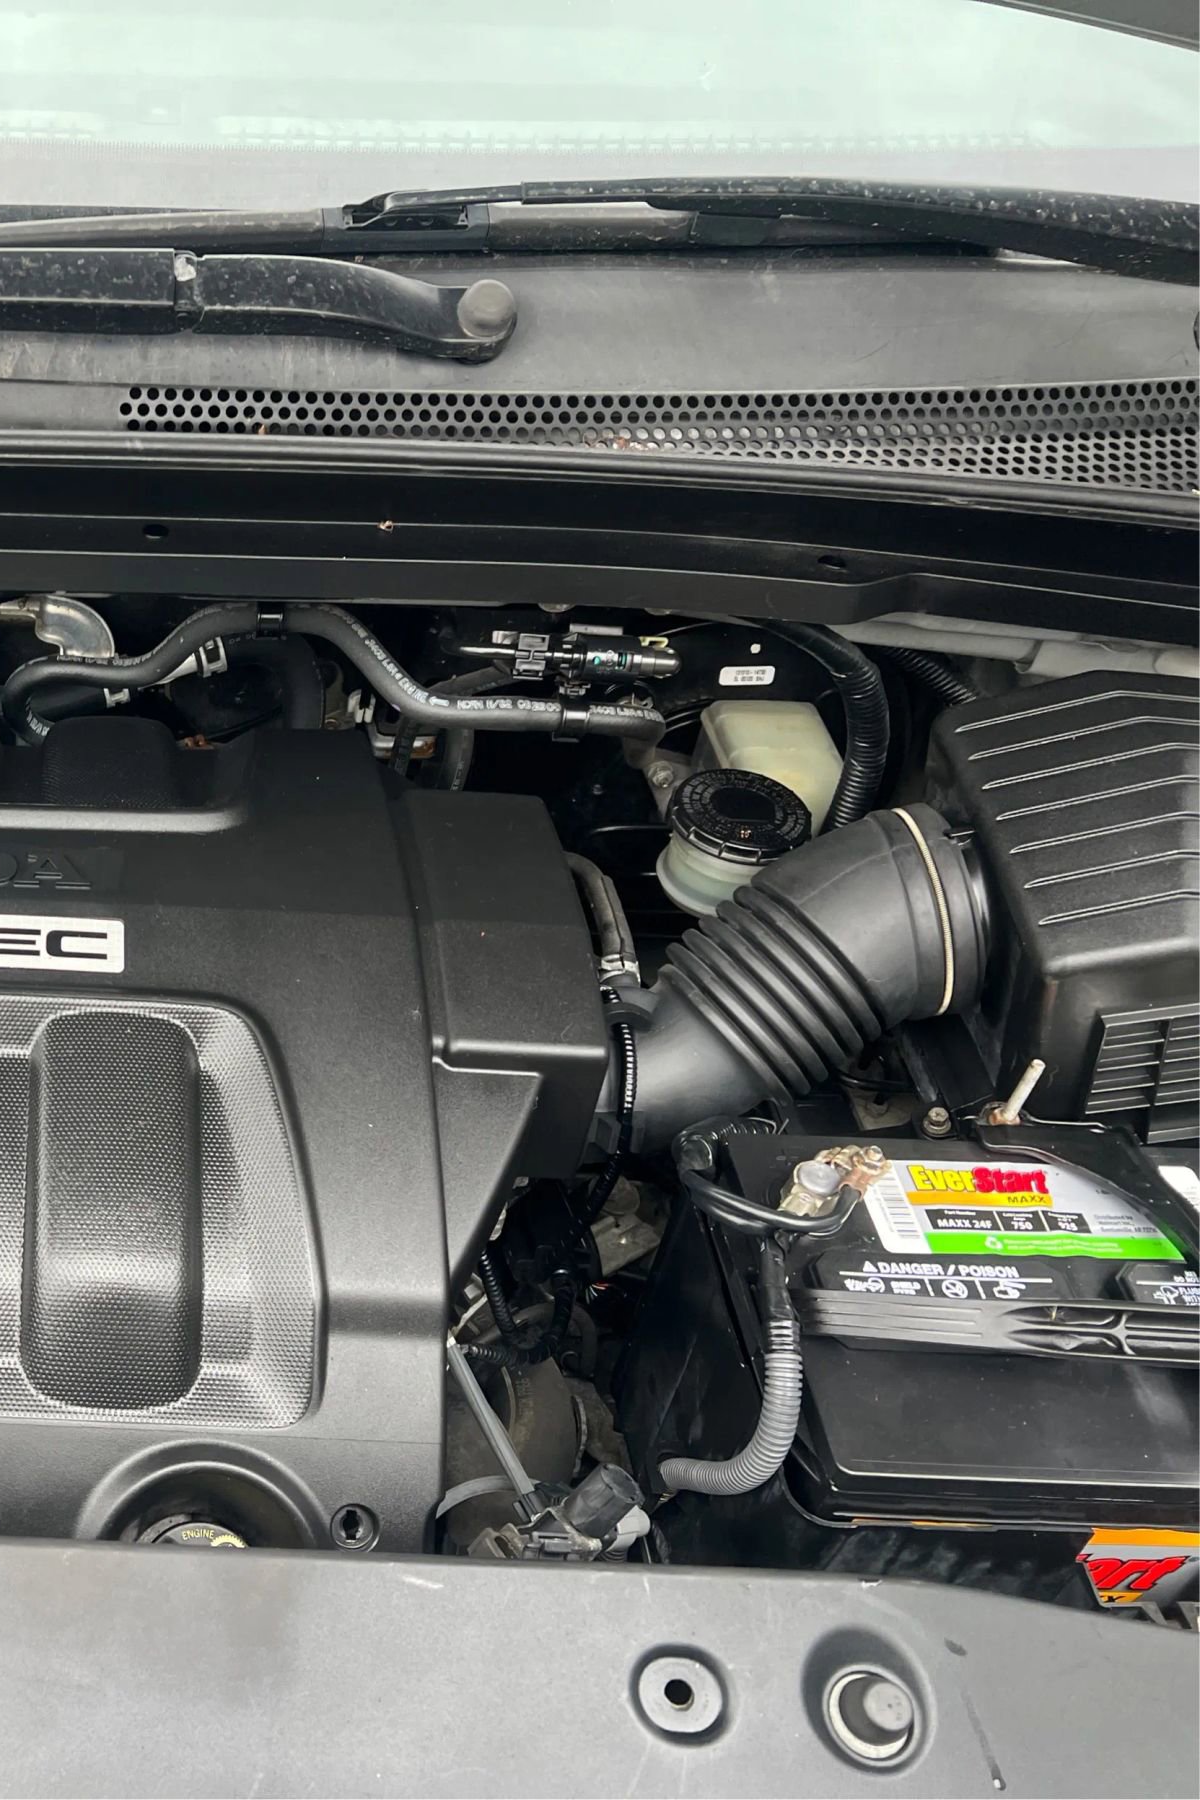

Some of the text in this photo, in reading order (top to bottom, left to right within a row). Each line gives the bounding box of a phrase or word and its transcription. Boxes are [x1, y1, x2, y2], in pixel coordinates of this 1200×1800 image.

[906, 1164, 1050, 1195] EverStart
[1006, 1195, 1047, 1205] MAXX
[936, 1218, 993, 1230] MAXX 24F
[1010, 1220, 1034, 1231] 750
[876, 1261, 944, 1276] DANGER
[958, 1264, 1020, 1279] POISON
[181, 1527, 216, 1541] ENGINE
